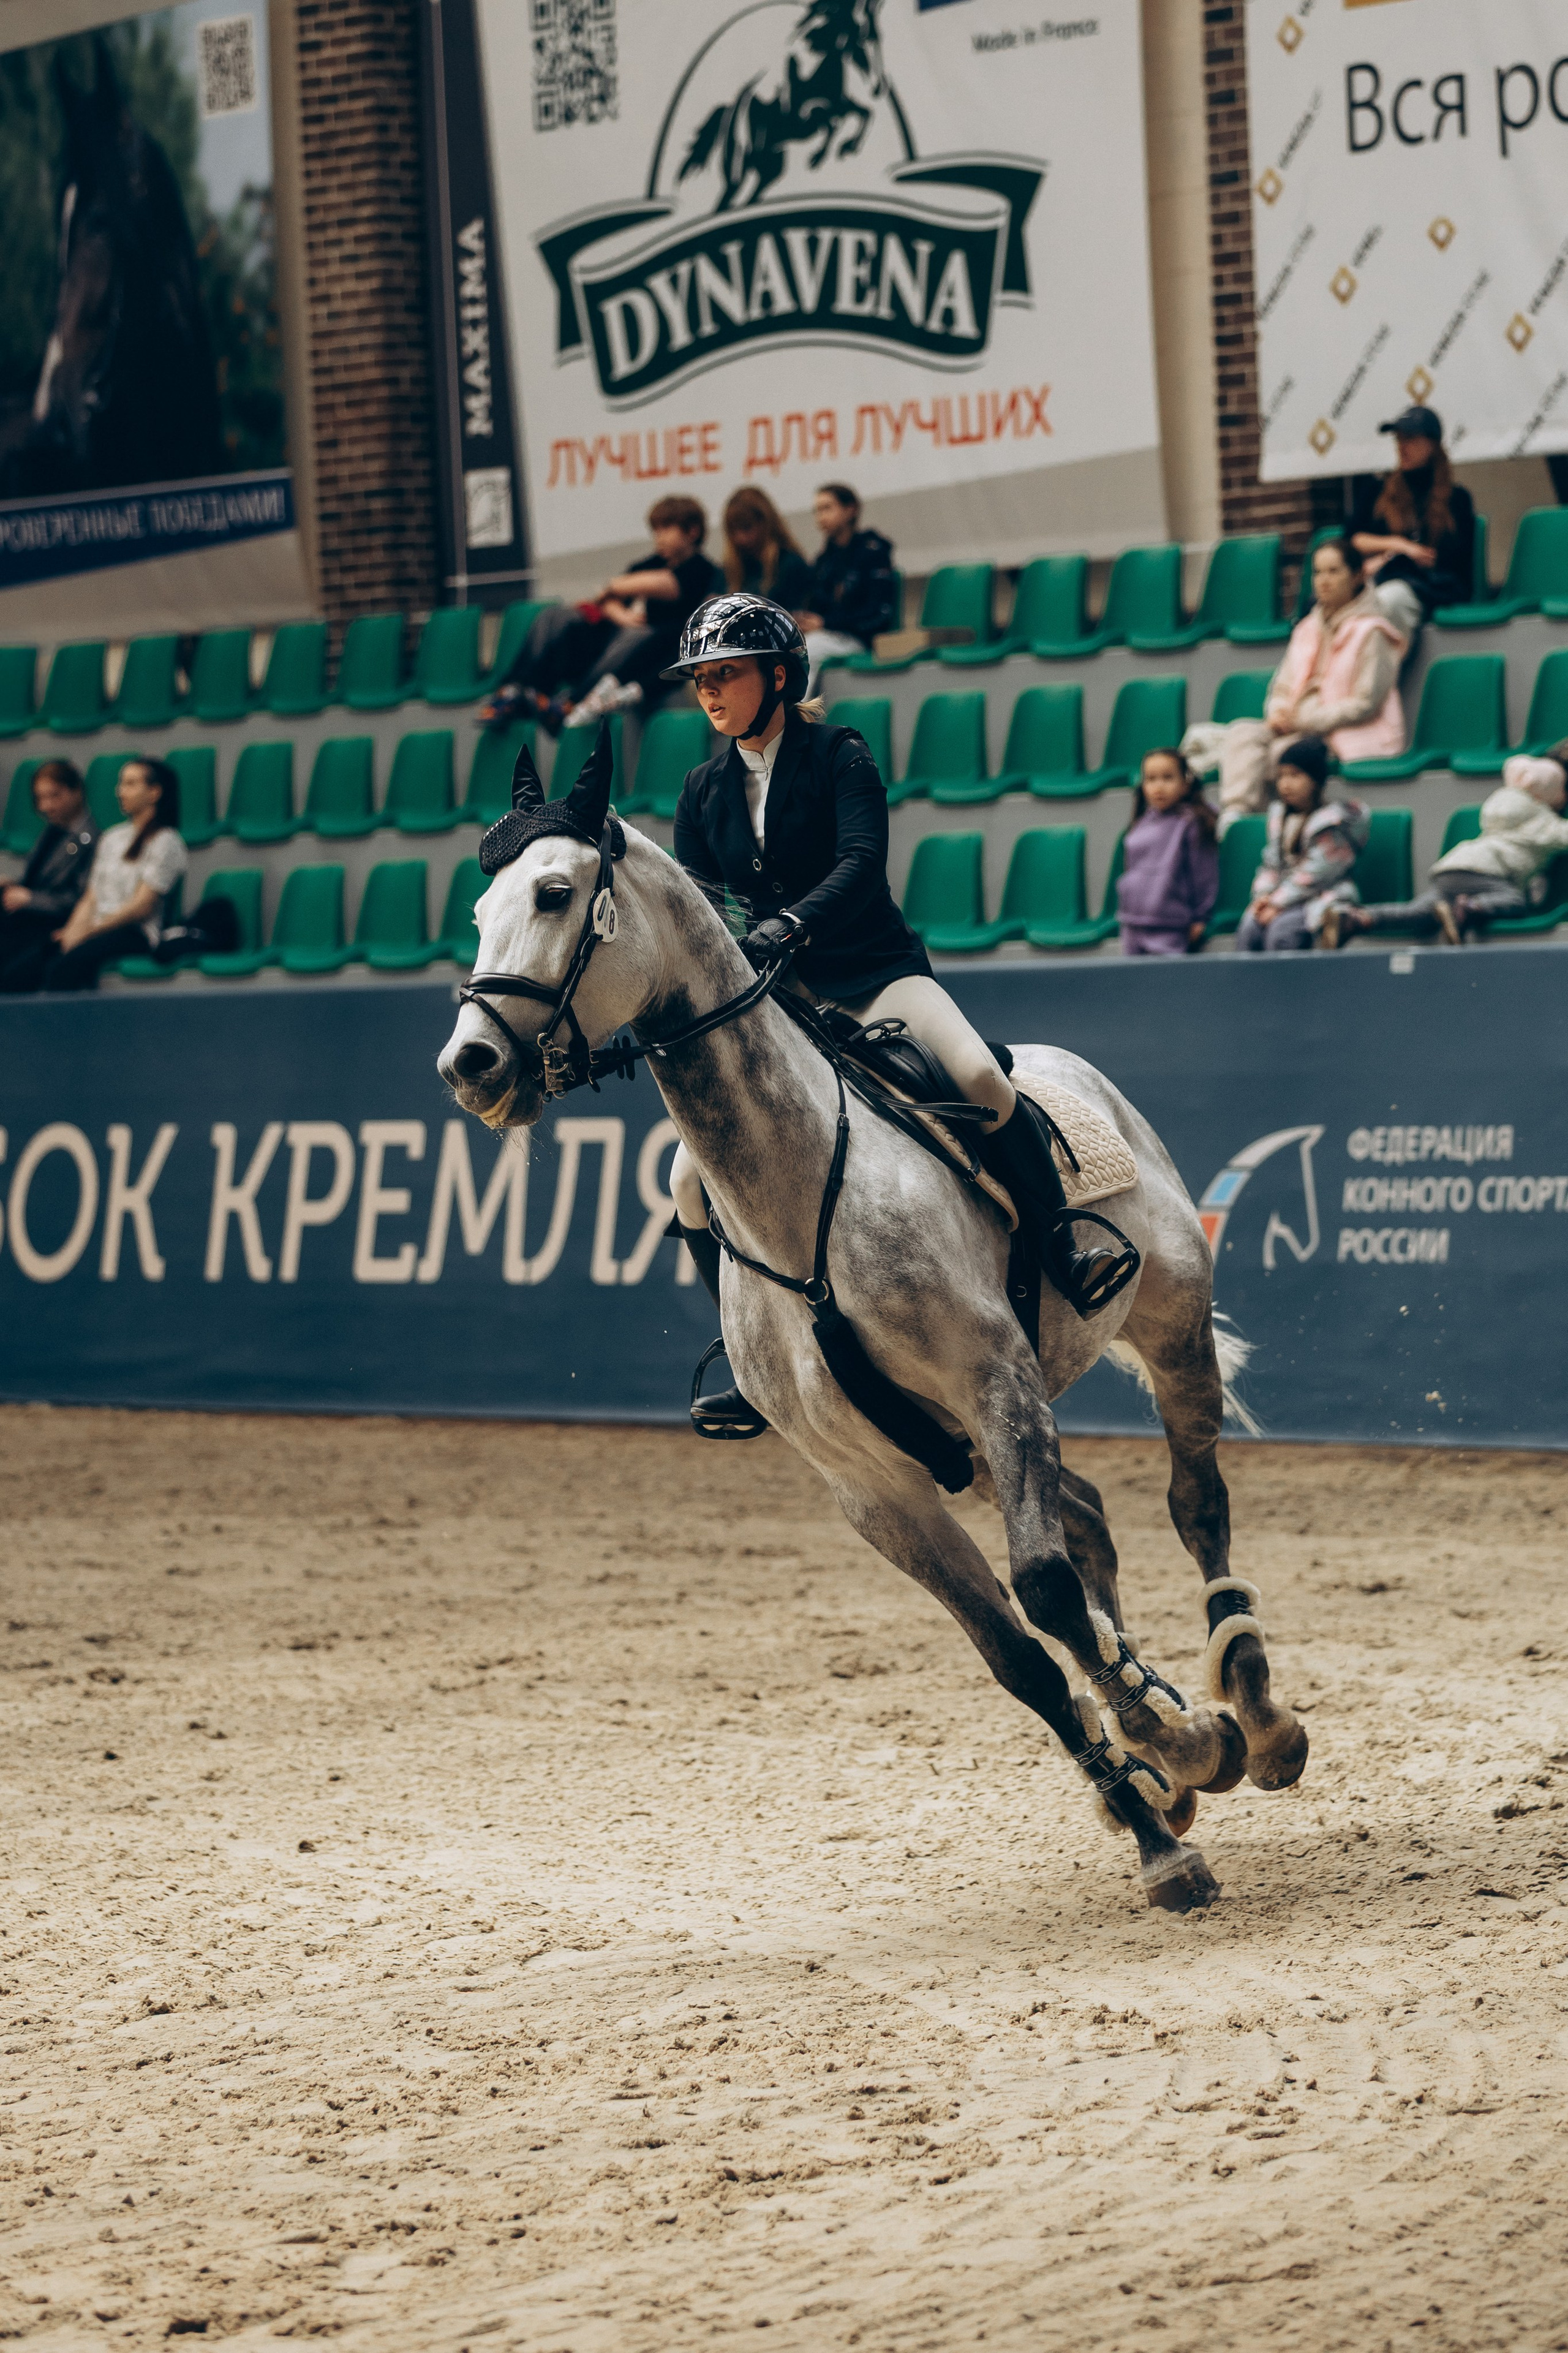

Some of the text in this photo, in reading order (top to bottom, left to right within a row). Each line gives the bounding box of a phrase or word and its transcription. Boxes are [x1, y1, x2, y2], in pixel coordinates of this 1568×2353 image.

[1346, 62, 1468, 152] Вся
[457, 217, 493, 437] MAXIMA
[600, 227, 980, 381] DYNAVENA
[546, 384, 1054, 488] ЛУЧШЕЕ ДЛЯ ЛУЧШИХ
[1342, 1174, 1568, 1214] КОННОГО СПОРТ
[1347, 1125, 1514, 1166] ФЕДЕРАЦИЯ
[0, 1116, 697, 1285] ОК КРЕМЛЯ
[1338, 1227, 1450, 1264] РОССИИ
